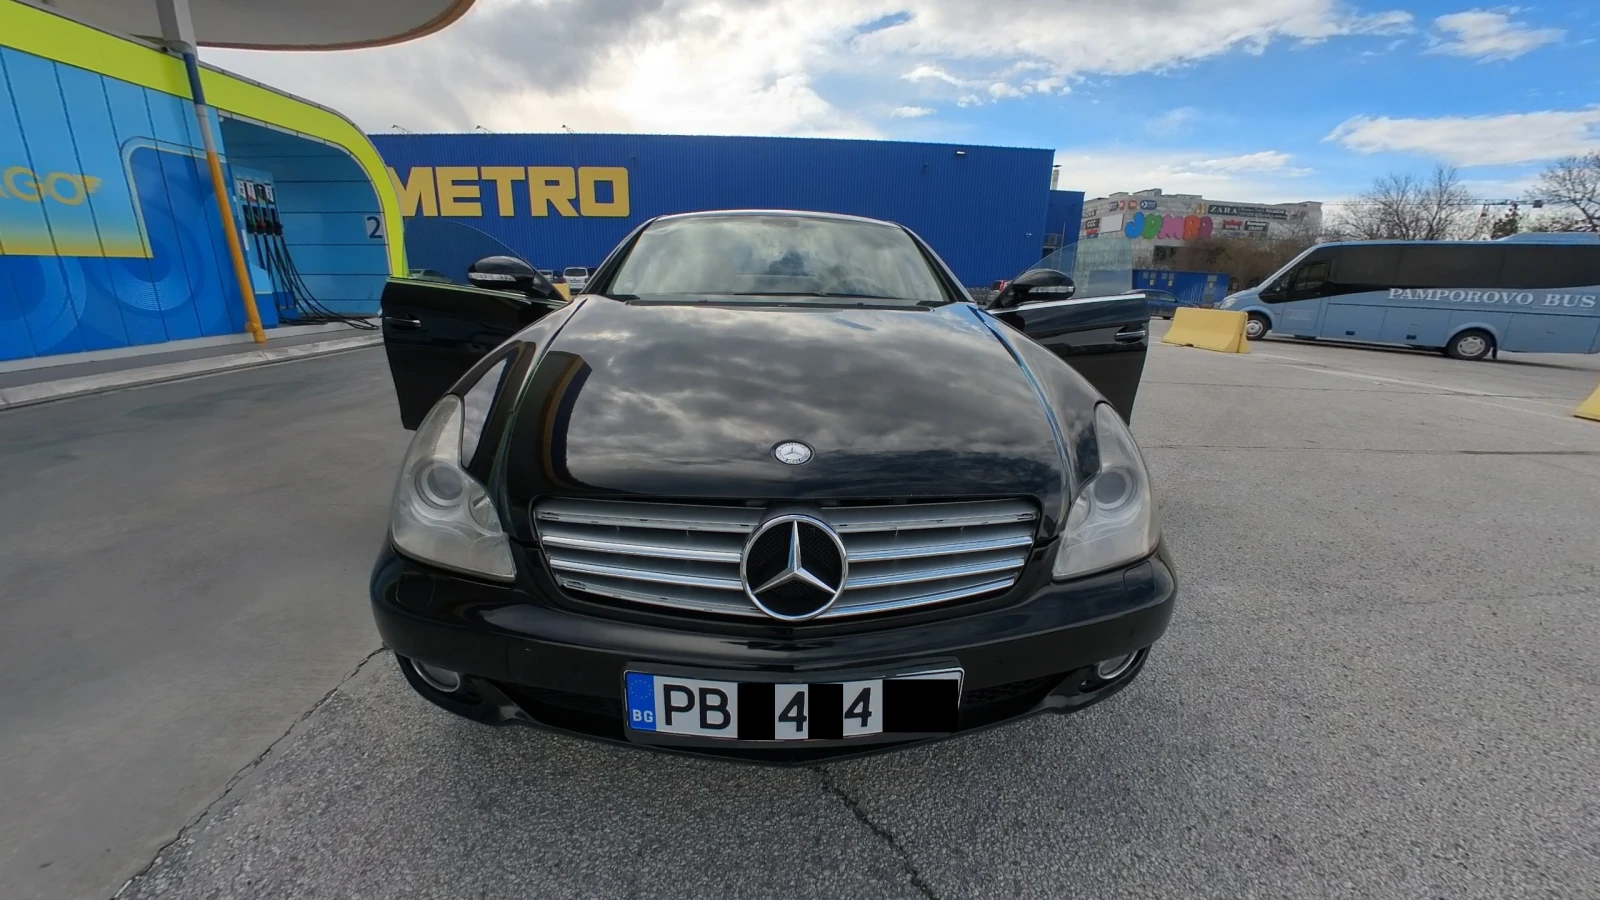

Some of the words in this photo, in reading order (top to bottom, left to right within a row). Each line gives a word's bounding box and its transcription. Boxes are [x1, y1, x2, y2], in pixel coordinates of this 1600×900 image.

[0, 165, 86, 206] GO
[386, 166, 630, 217] METRO
[1210, 206, 1238, 214] ZARA
[366, 216, 383, 239] 2
[1124, 211, 1214, 241] JUMBO
[1388, 288, 1533, 305] PAMPOROVO
[1542, 294, 1596, 308] BUS
[632, 709, 654, 723] BG
[663, 684, 731, 730] PB
